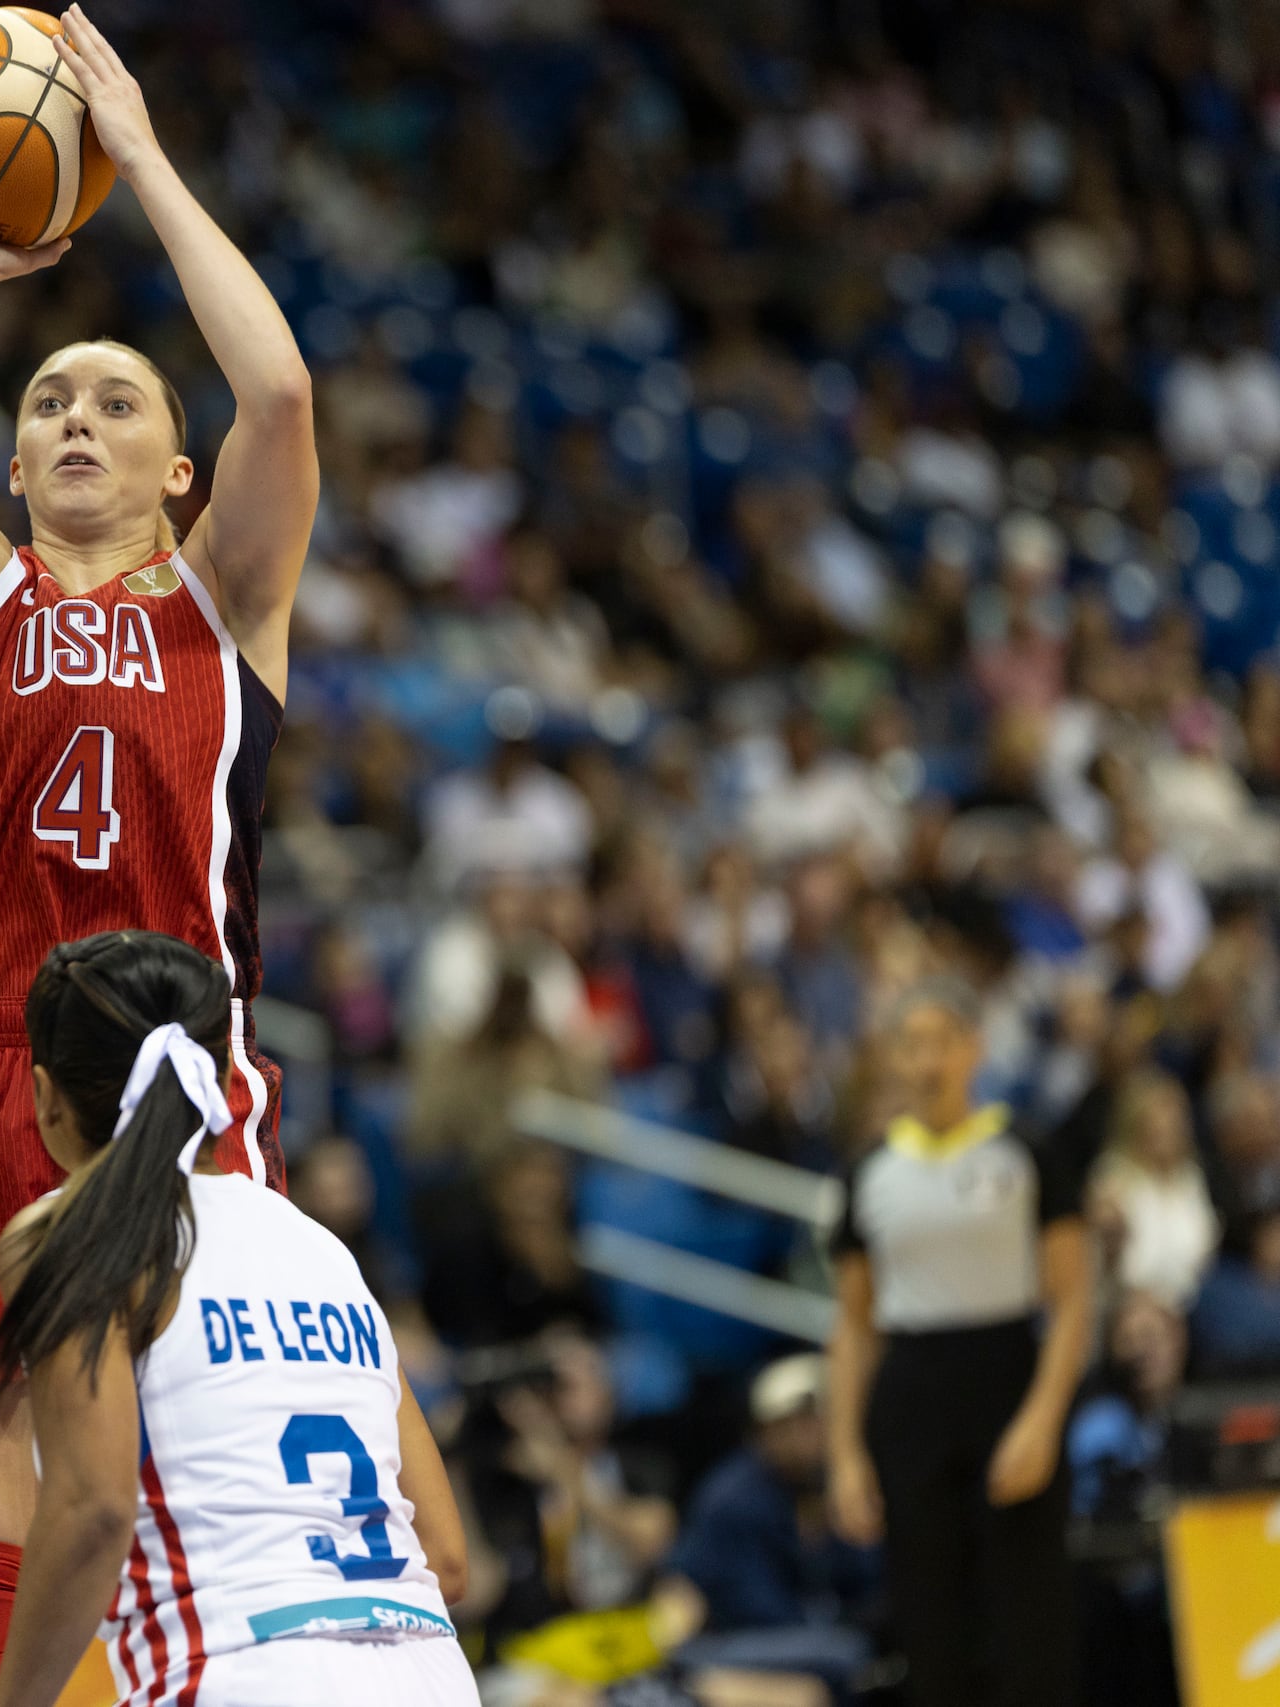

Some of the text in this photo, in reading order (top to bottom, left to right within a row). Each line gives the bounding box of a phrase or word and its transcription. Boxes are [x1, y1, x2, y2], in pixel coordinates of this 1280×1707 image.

[12, 598, 166, 696] USA
[33, 725, 121, 870] 4
[199, 1298, 381, 1369] DE LEON
[278, 1414, 409, 1582] 3
